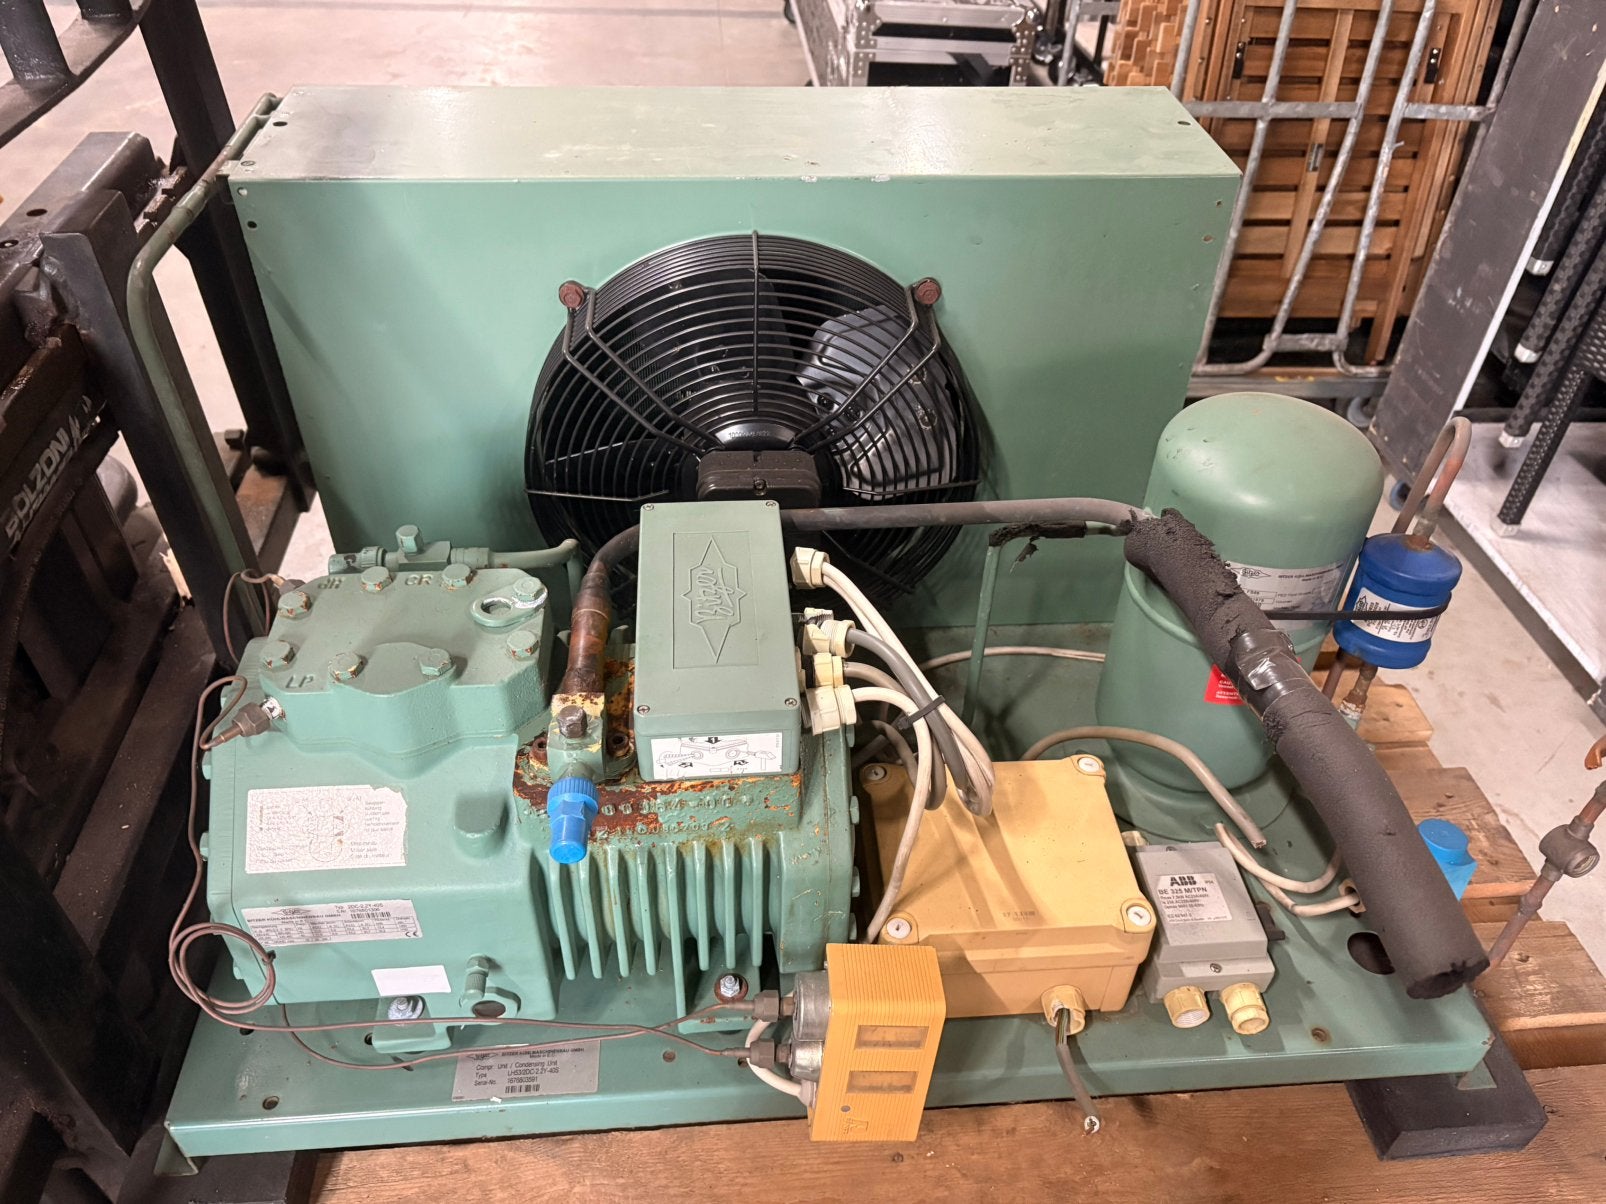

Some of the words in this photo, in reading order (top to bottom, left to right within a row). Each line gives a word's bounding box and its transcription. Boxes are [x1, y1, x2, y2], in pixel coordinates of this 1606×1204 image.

[695, 566, 735, 624] Bitzer
[285, 674, 315, 689] LP
[1170, 876, 1197, 887] ABB
[515, 1061, 545, 1069] Condensing
